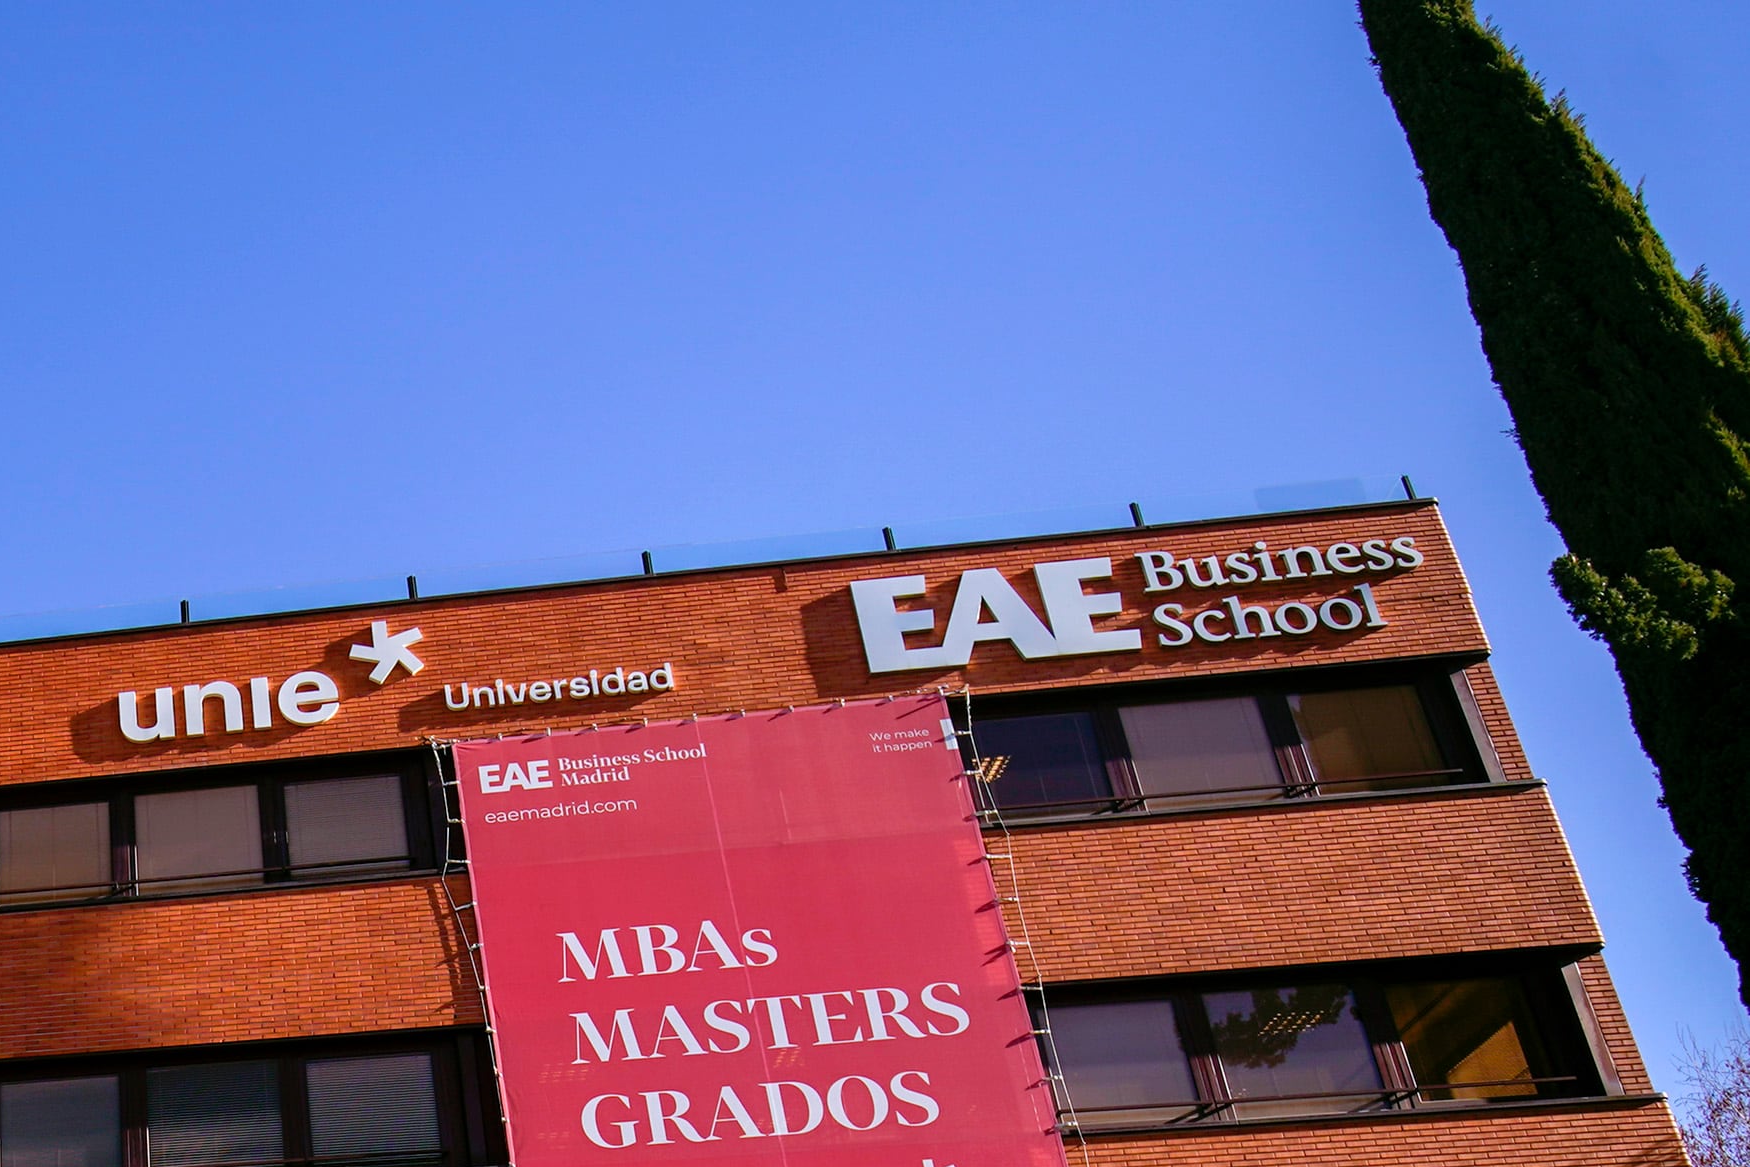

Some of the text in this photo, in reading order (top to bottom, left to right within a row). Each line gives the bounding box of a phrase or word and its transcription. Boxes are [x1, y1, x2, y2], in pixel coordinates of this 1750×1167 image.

[1134, 535, 1424, 594] Business
[850, 557, 1143, 674] EAE
[1152, 583, 1389, 648] School
[443, 662, 675, 712] Universidad
[557, 743, 708, 771] Business School
[869, 728, 930, 742] We make
[872, 740, 933, 753] it happen
[478, 759, 554, 794] EAE
[560, 766, 631, 787] Madrid
[484, 798, 638, 824] eaemadrid.com
[556, 919, 779, 983] MBAs
[568, 981, 971, 1065] MASTERS
[580, 1070, 941, 1149] GRADOS
